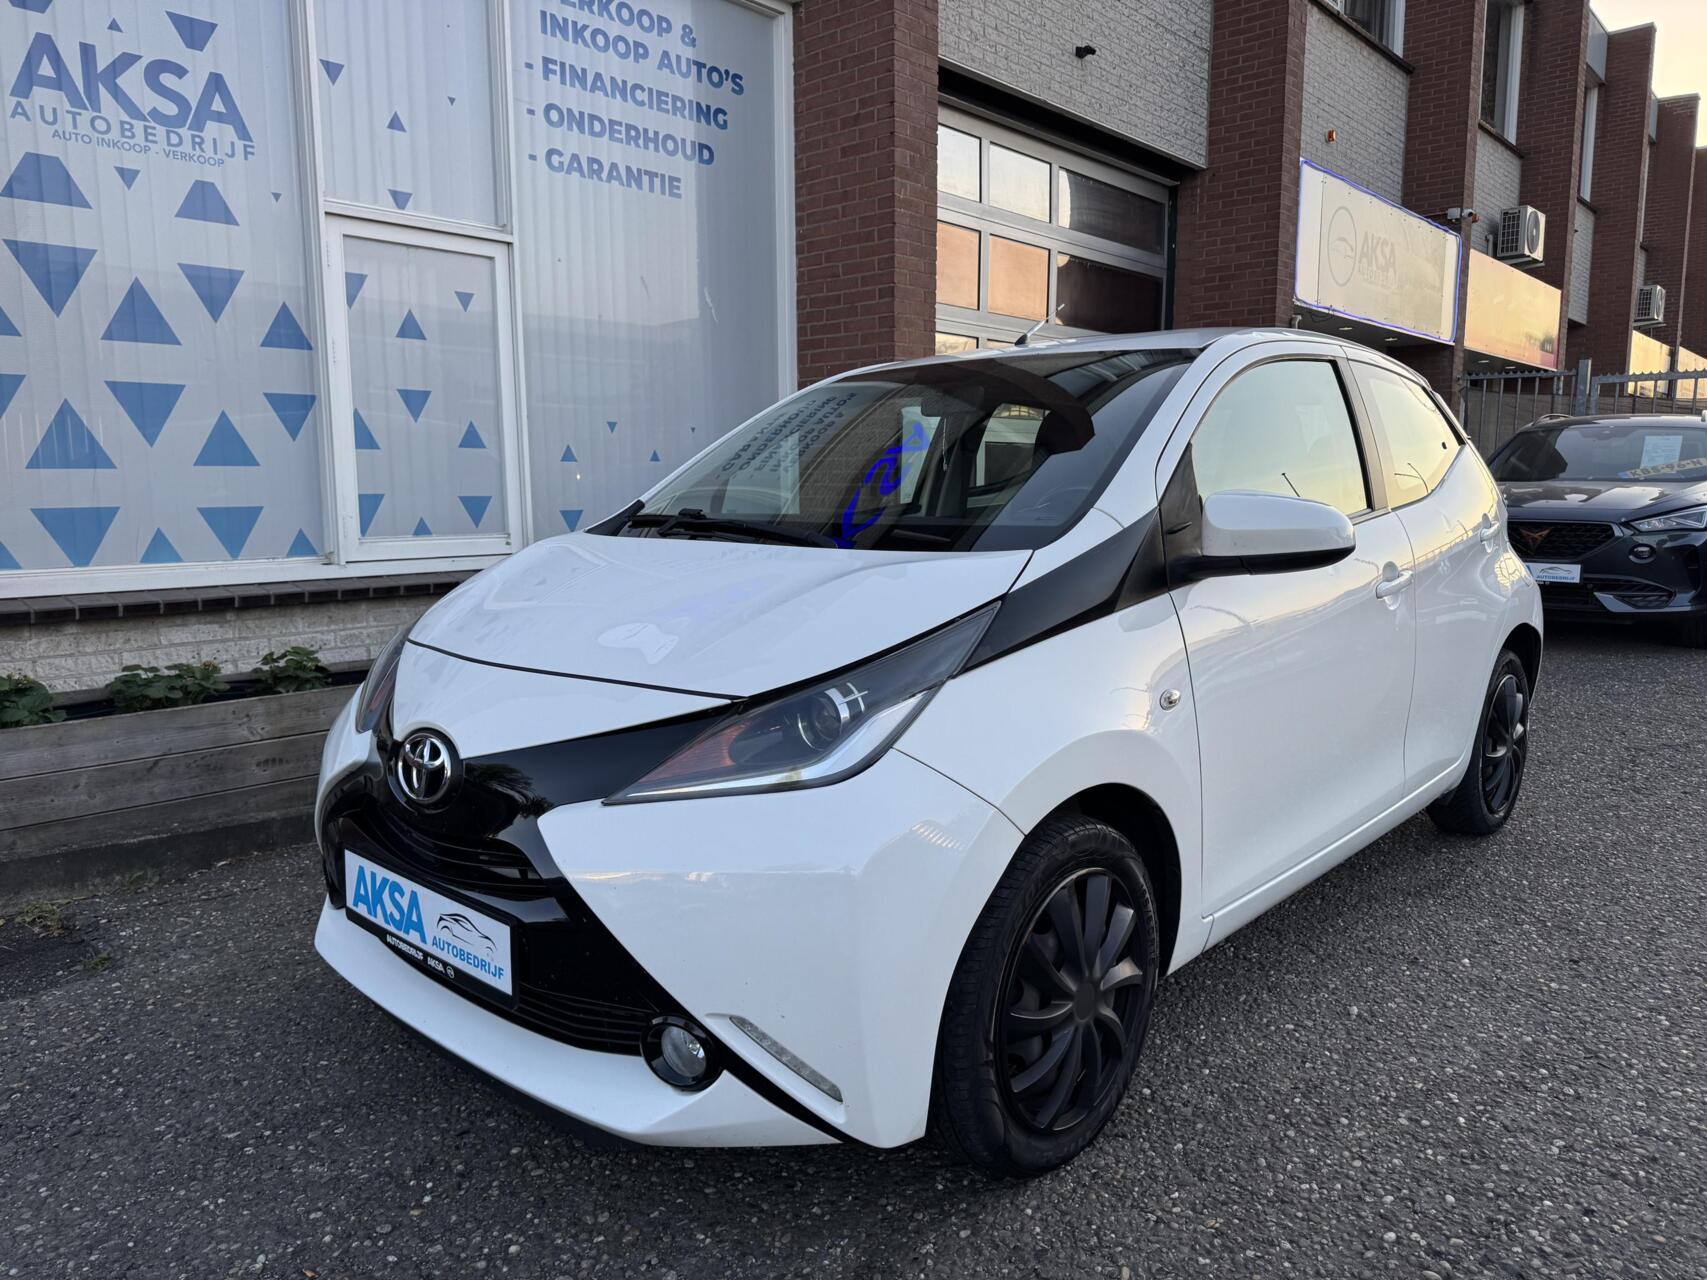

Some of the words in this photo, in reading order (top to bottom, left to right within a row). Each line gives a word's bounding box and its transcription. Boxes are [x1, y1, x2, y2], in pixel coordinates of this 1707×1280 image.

[540, 10, 649, 64] INKOOP
[657, 50, 744, 96] AUTO'S
[560, 0, 672, 37] RKOOP
[680, 24, 696, 48] &
[9, 32, 254, 143] AKSA
[541, 56, 728, 130] FINANCIERING
[9, 101, 255, 161] AUTOBEDRIJF
[52, 129, 91, 144] AUTO
[97, 137, 150, 155] INKOOP
[163, 149, 224, 167] VERKOOP
[543, 103, 714, 165] ONDERHOUD
[545, 148, 682, 199] GARANTIE
[1358, 231, 1396, 279] AKSA
[353, 865, 427, 944] AKSA
[432, 936, 504, 979] AUTOBEDRIJF
